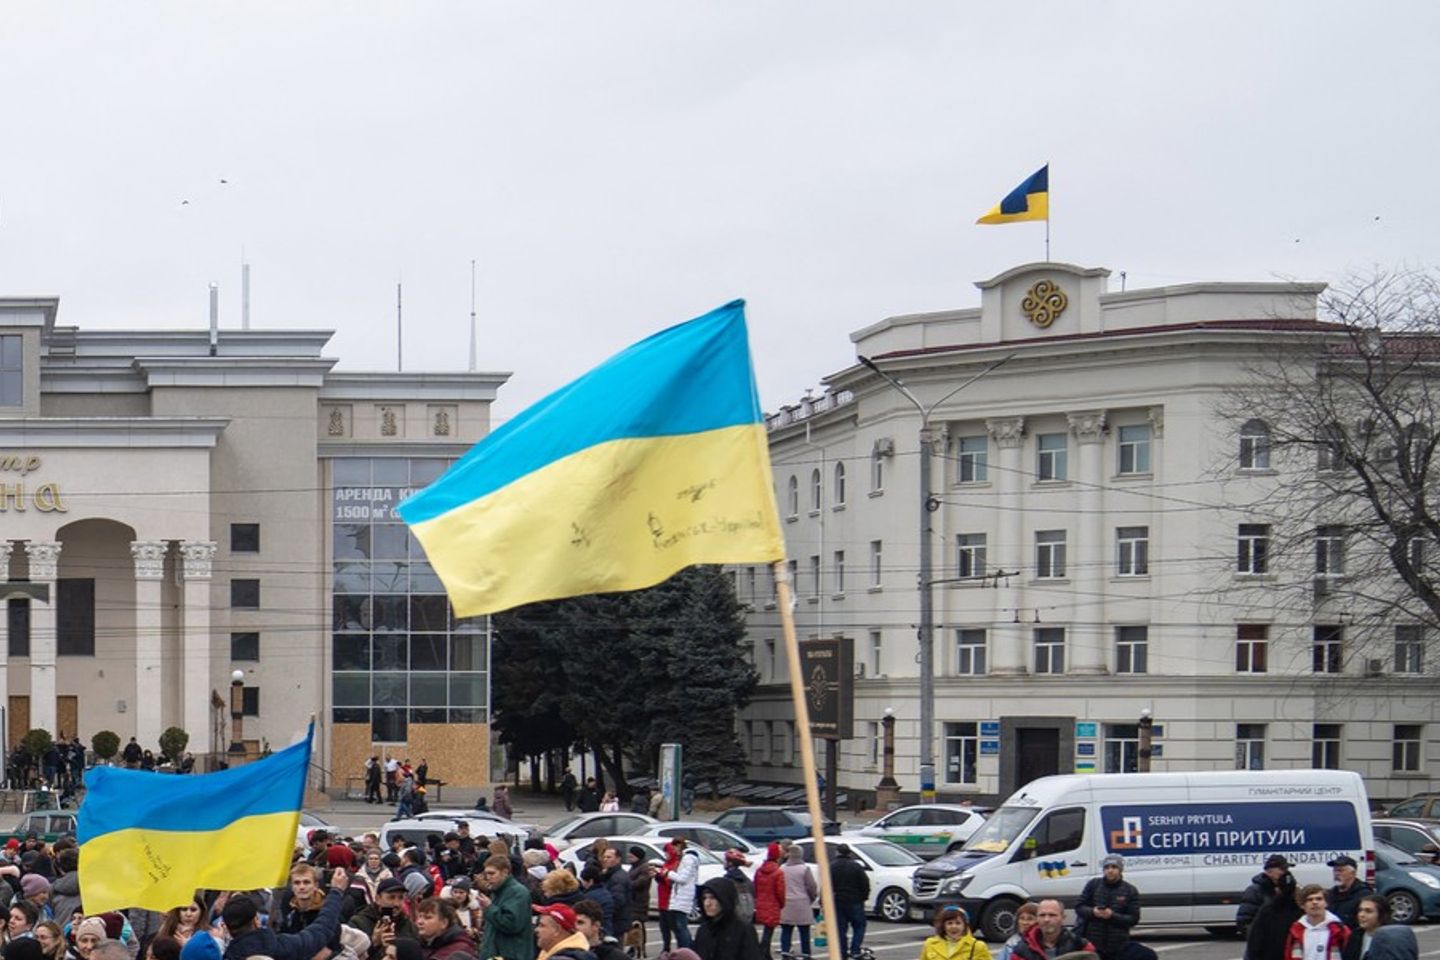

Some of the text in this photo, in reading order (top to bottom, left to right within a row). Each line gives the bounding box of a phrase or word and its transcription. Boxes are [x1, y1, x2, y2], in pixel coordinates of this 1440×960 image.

[336, 488, 392, 501] АРЕНДА
[336, 506, 370, 518] 1500
[1148, 814, 1233, 826] SERHIY PRYTULA
[1149, 829, 1305, 848] СЕРГІЯ ПРИТУЛИ
[1203, 854, 1259, 866] CHARITY
